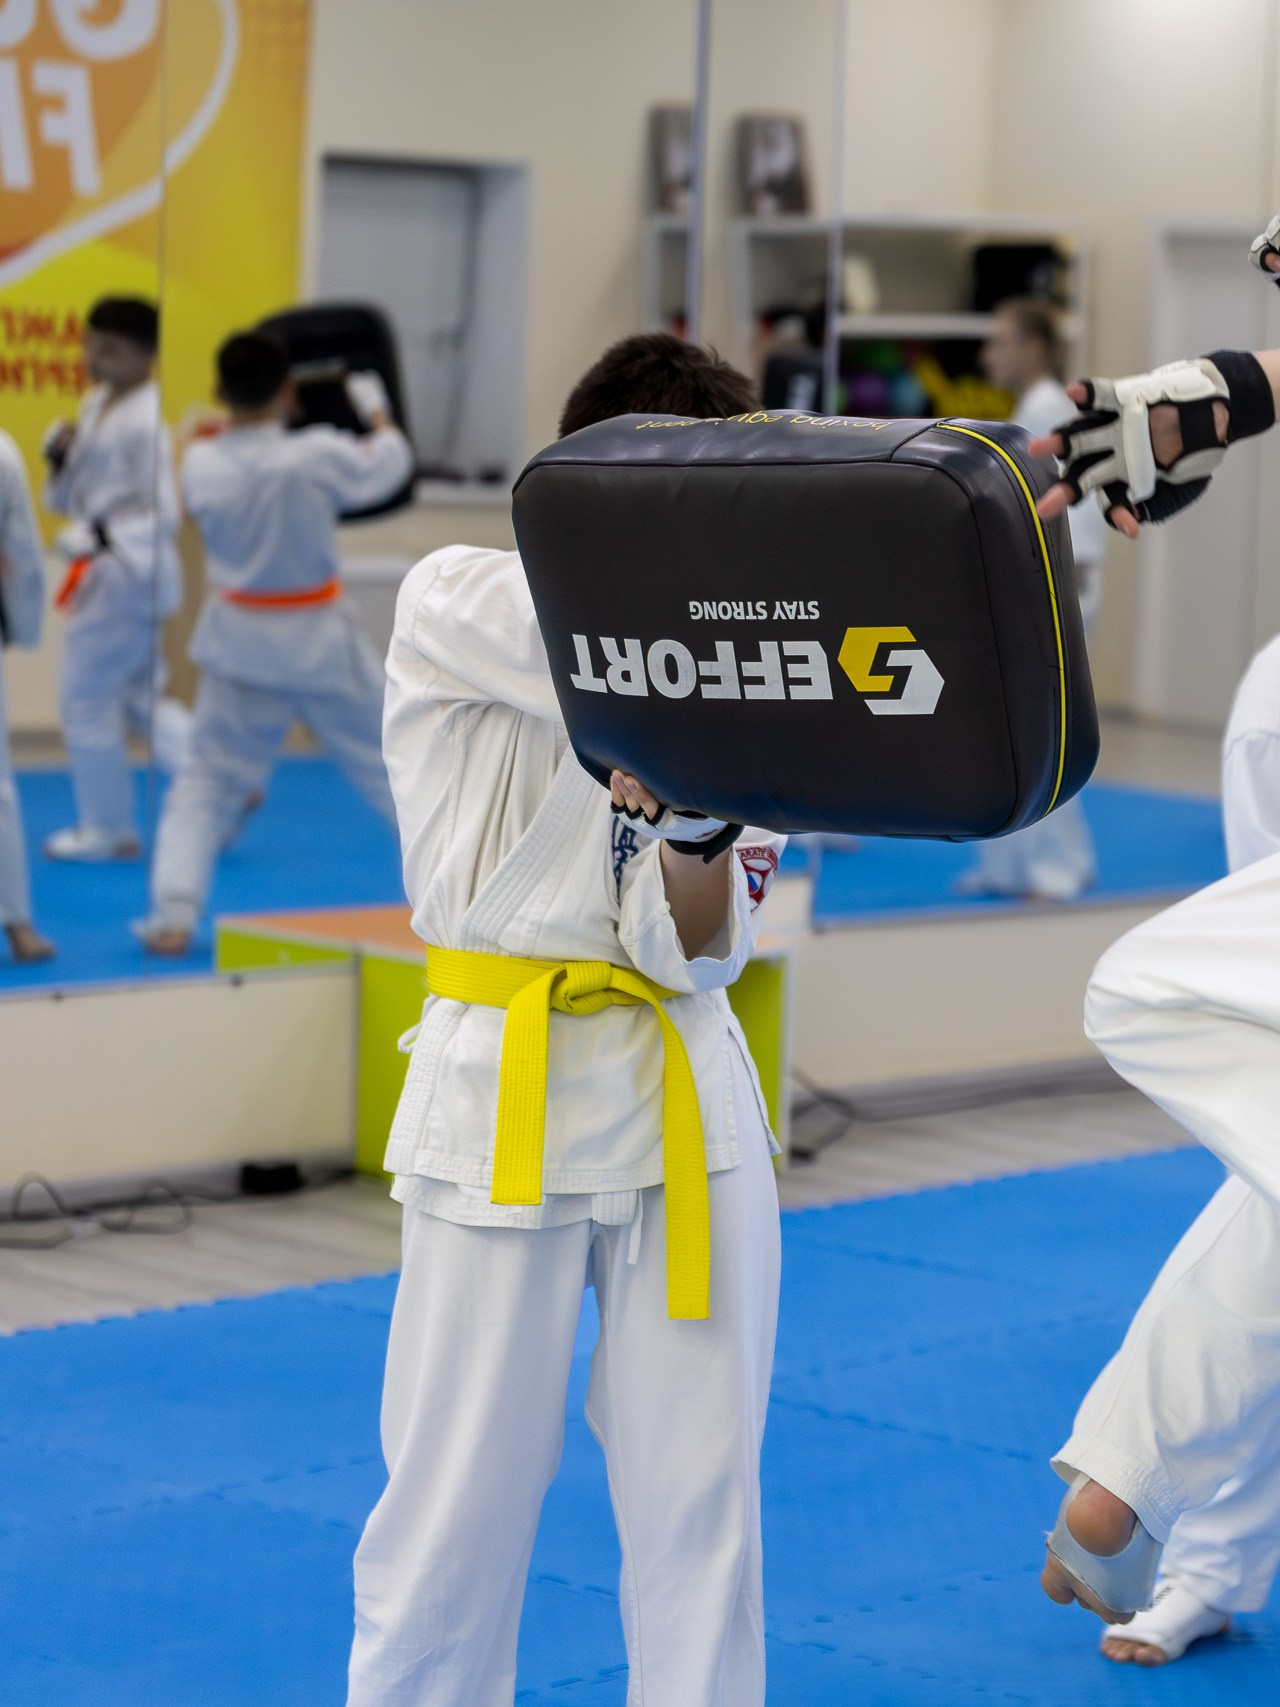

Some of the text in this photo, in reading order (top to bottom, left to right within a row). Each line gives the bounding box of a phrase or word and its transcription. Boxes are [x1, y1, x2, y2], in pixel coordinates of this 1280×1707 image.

[635, 410, 783, 430] equment
[688, 600, 820, 620] STAY STRONG
[570, 633, 834, 700] EFFORT
